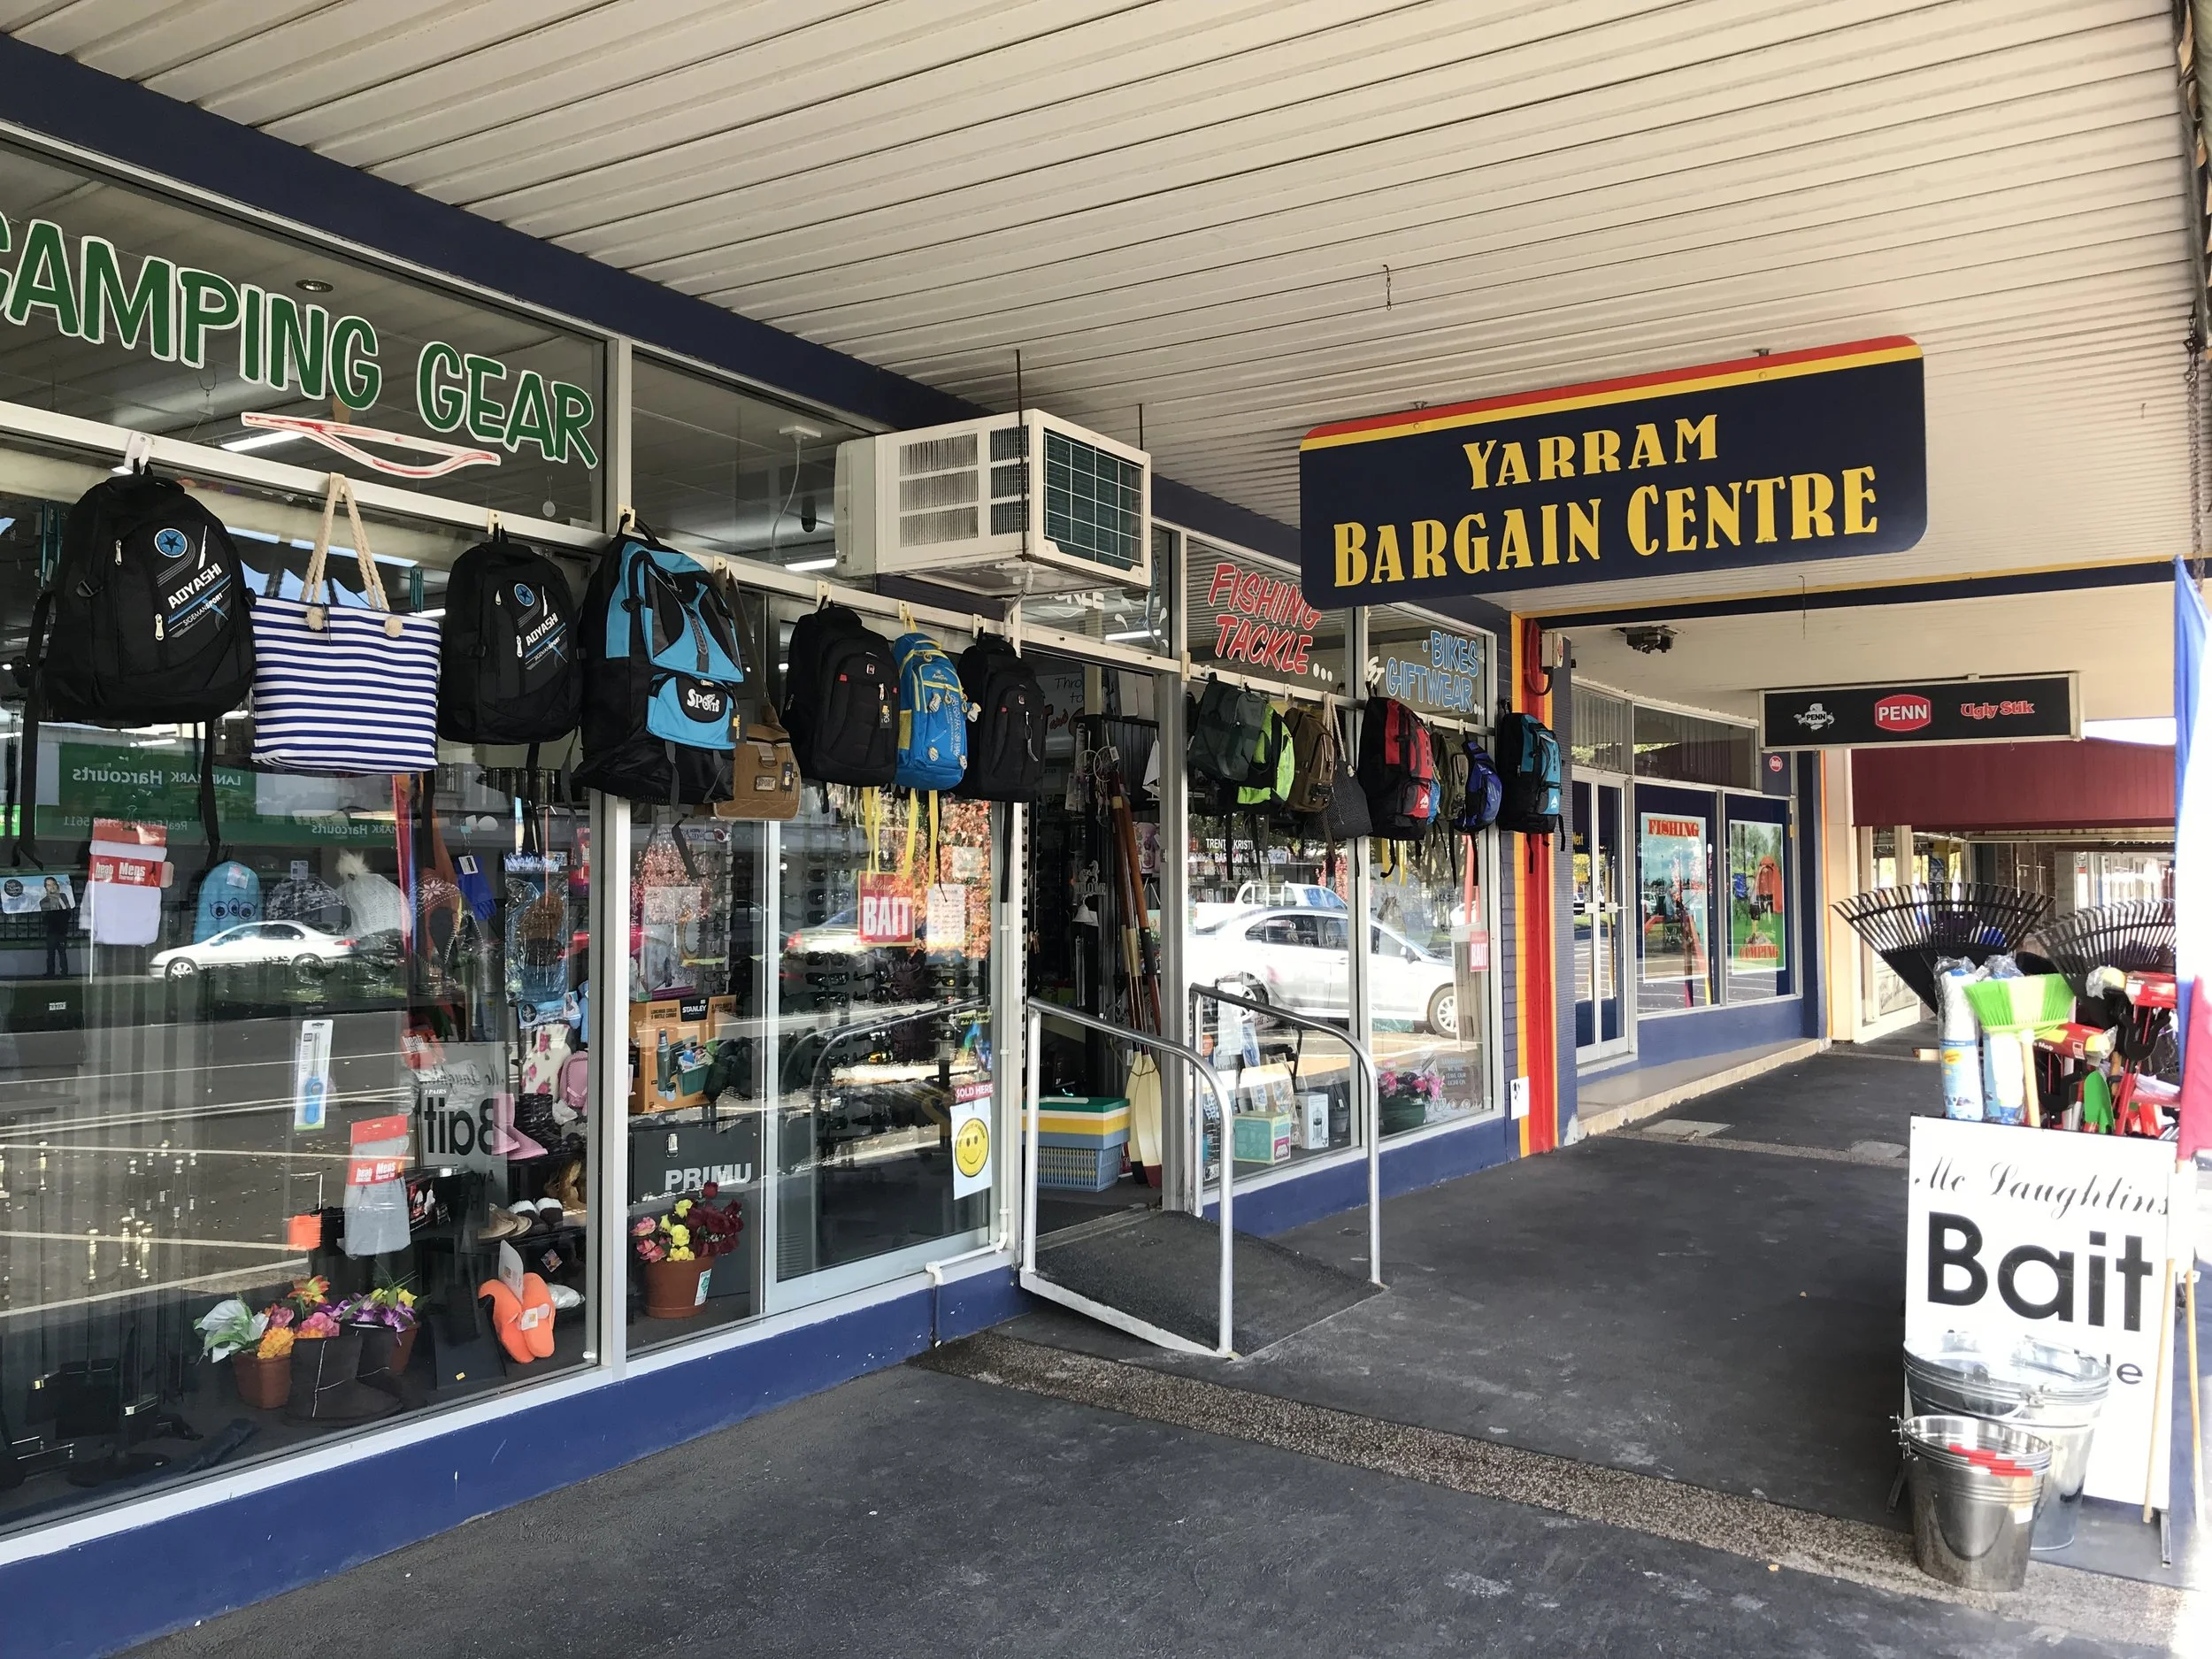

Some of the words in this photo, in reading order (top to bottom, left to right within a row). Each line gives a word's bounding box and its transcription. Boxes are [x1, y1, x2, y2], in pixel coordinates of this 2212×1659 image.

[417, 341, 598, 468] GEAR
[1463, 414, 1717, 489] YARRAM
[1333, 498, 1601, 588] BARGAIN
[1627, 465, 1878, 556] CENTRE
[1208, 563, 1322, 631] FISHING
[1431, 630, 1479, 678] BIKES
[1806, 712, 1826, 721] PENN
[1878, 703, 1927, 720] PENN
[1960, 702, 1998, 720] Ugly
[2000, 700, 2034, 716] Stik
[1647, 819, 1700, 837] FISHING
[863, 896, 912, 937] BAIT
[682, 1004, 708, 1014] STANLEY
[956, 1087, 974, 1098] SOLD
[975, 1083, 994, 1095] HERE
[1928, 1210, 2153, 1332] Bait
